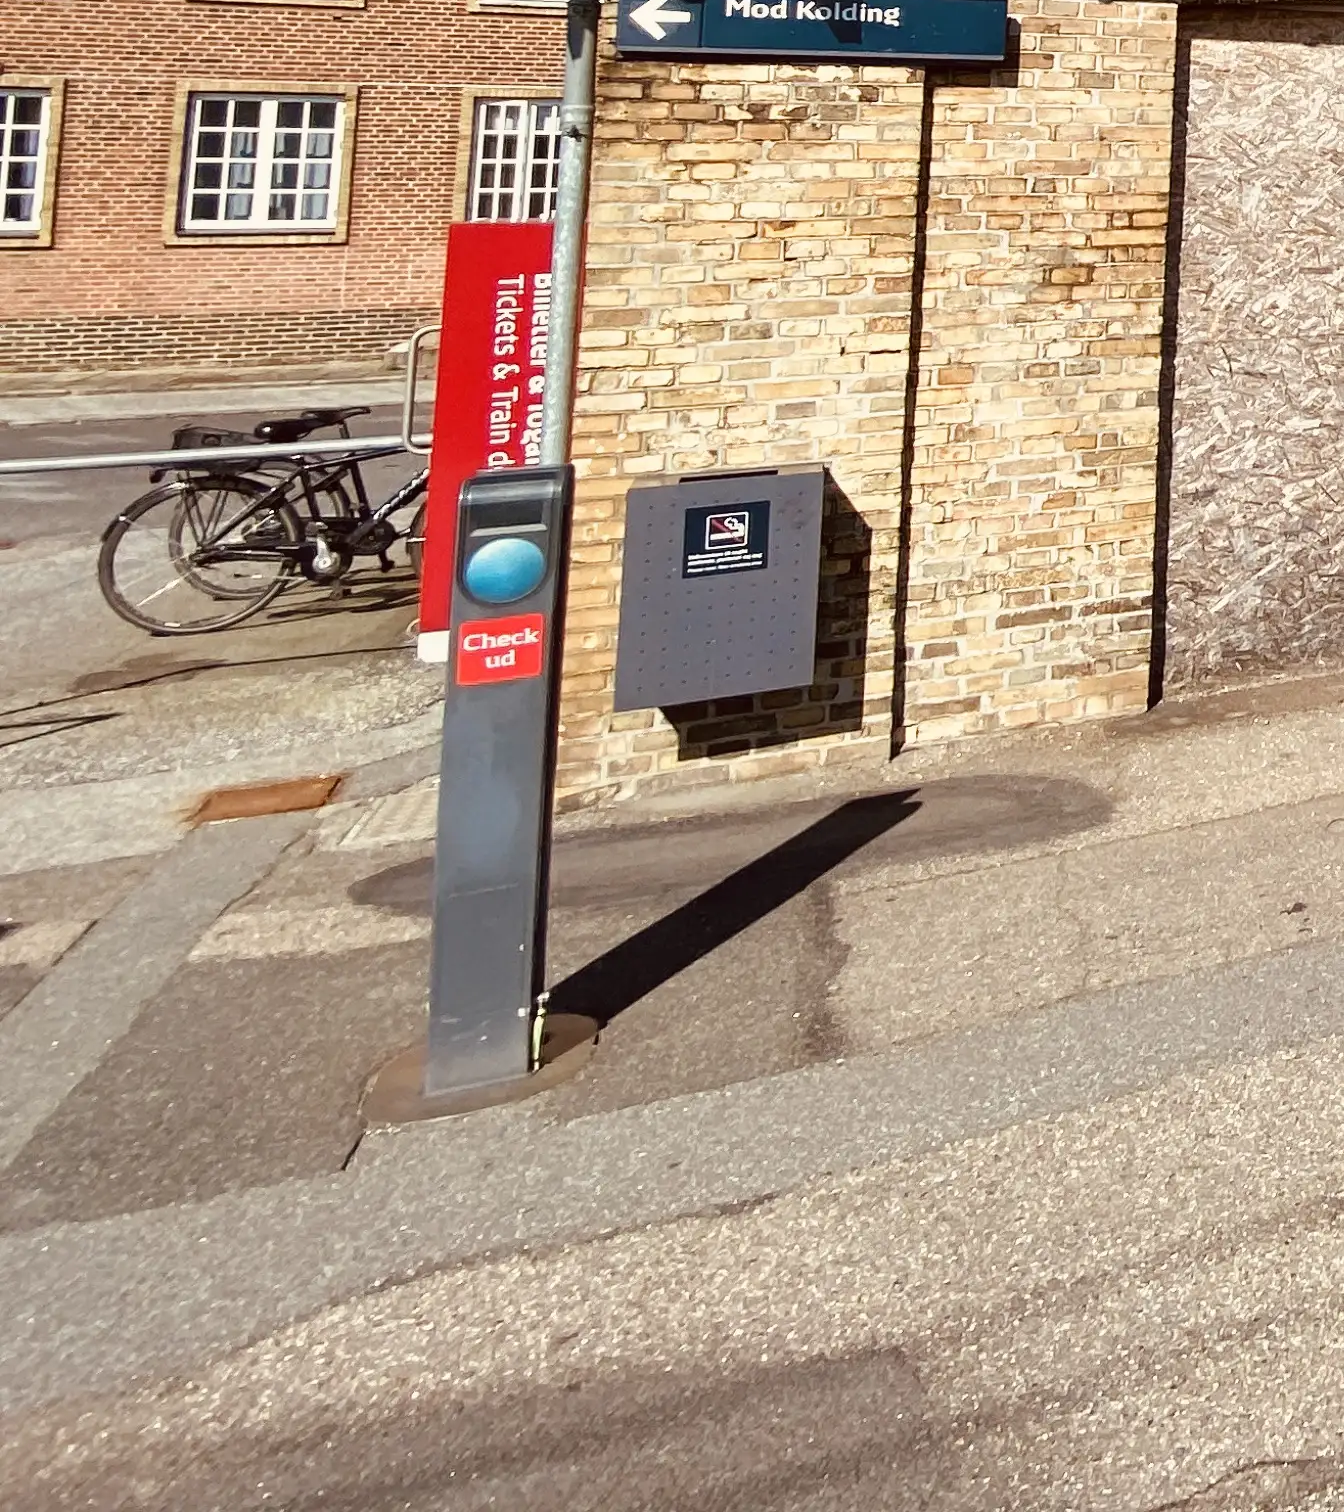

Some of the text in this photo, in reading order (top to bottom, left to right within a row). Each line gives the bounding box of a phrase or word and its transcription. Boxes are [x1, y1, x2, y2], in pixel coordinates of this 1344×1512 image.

[796, 0, 900, 27] Kolding
[493, 273, 525, 356] Tickets
[492, 363, 521, 381] &
[488, 385, 519, 445] Train
[462, 627, 541, 652] Check
[484, 648, 516, 669] ud
